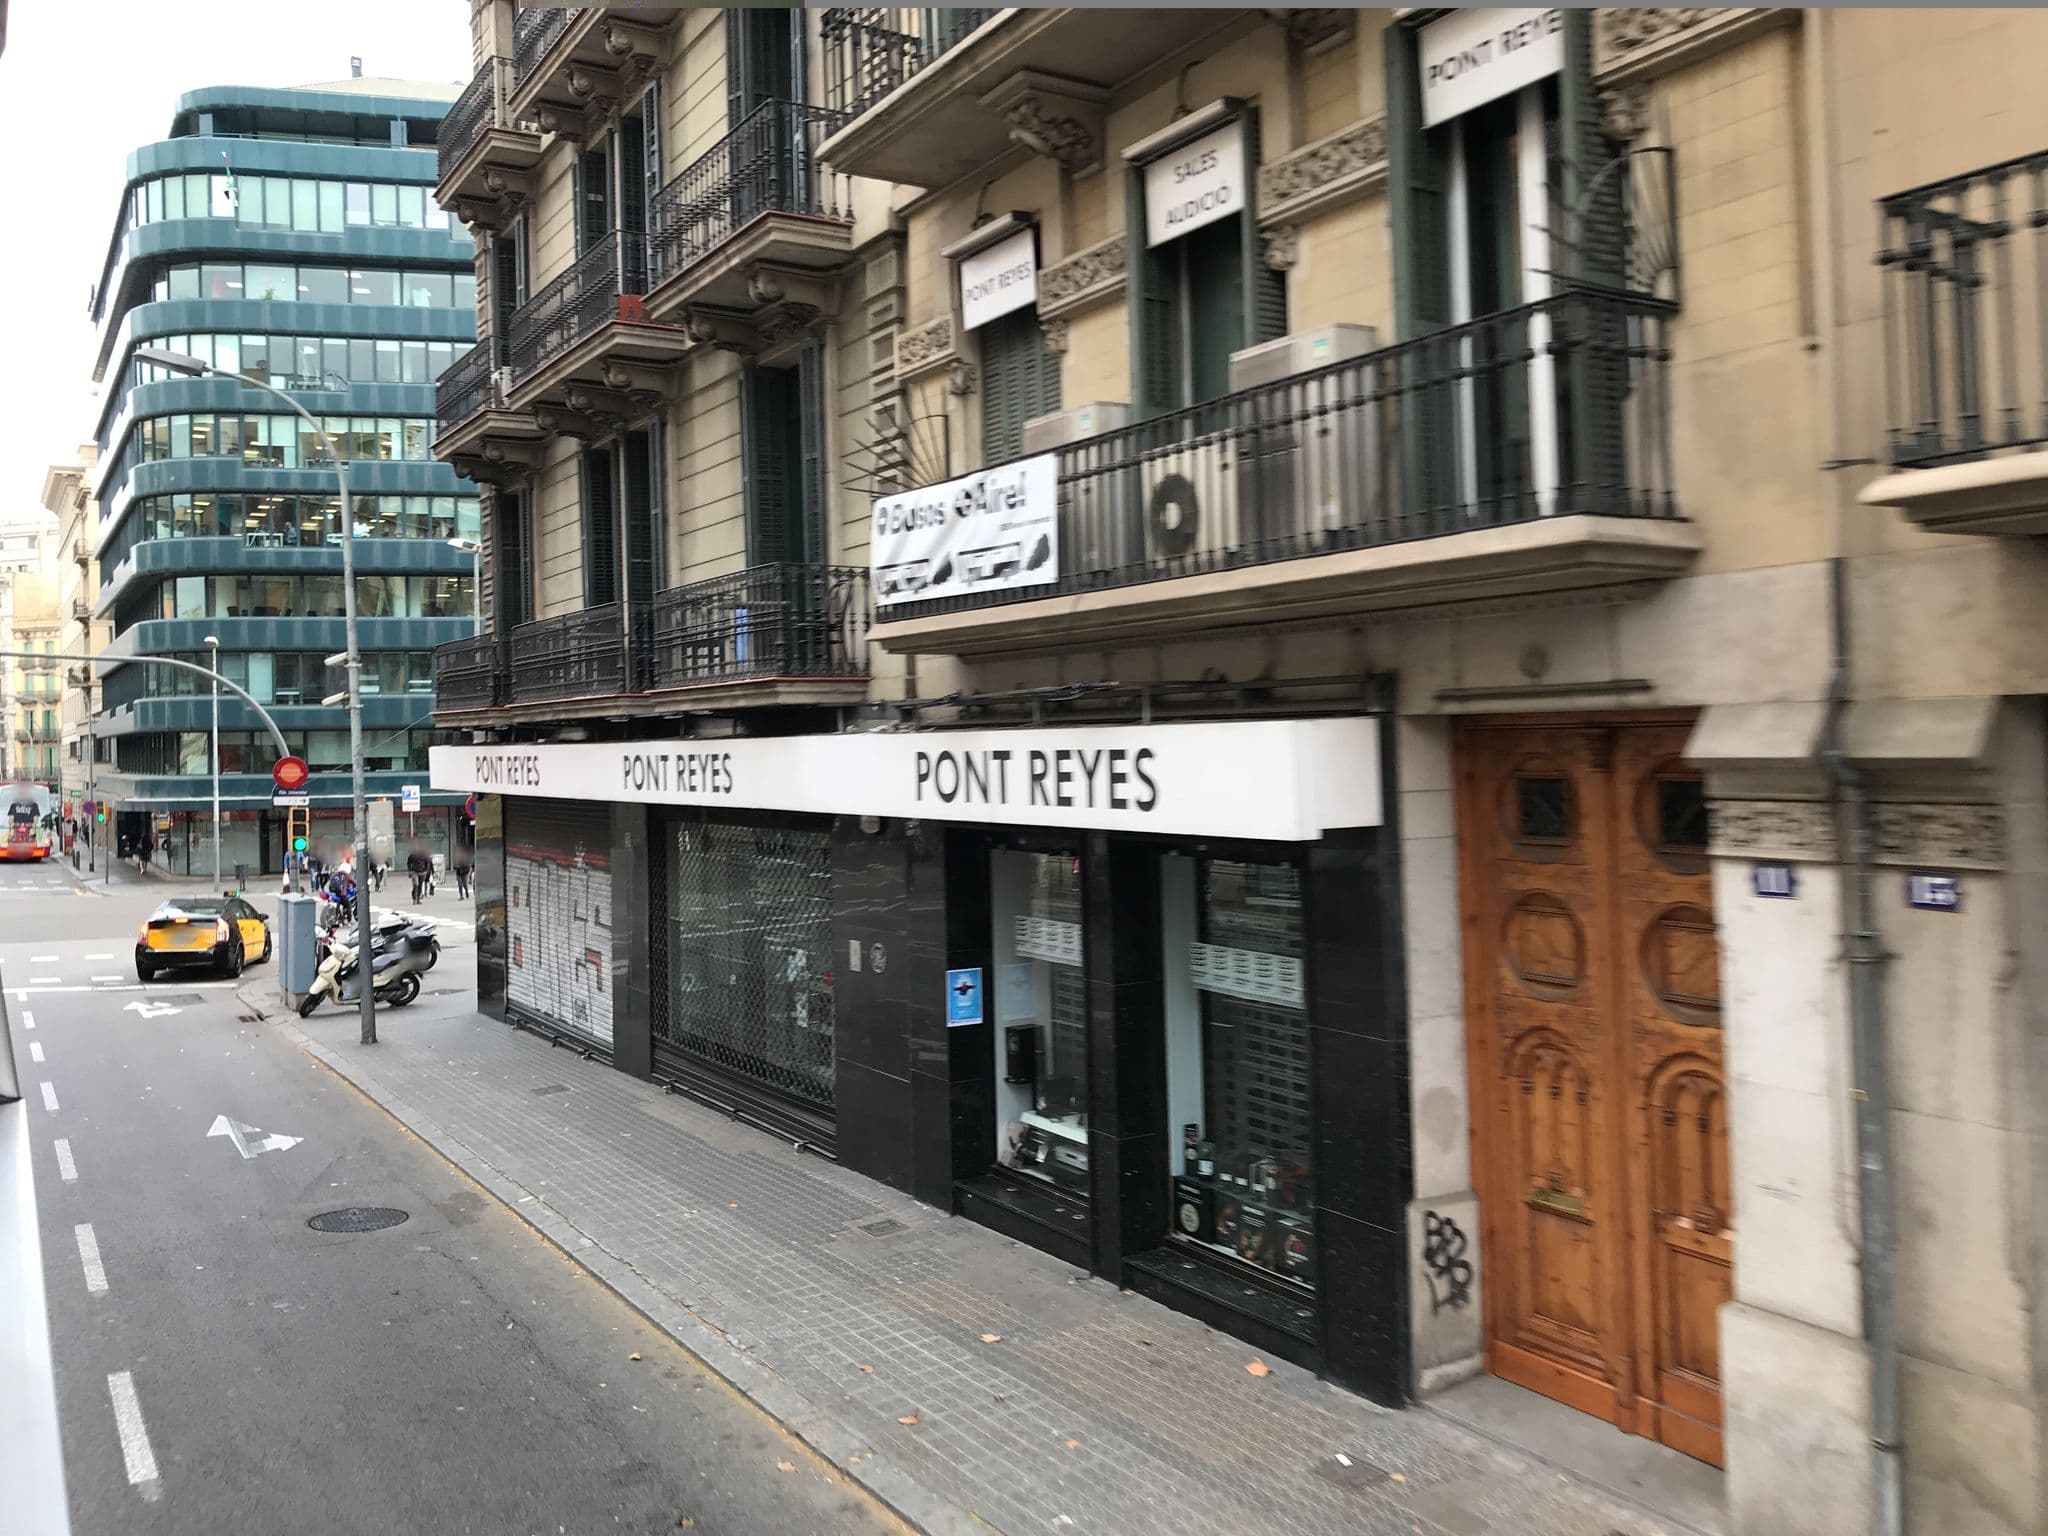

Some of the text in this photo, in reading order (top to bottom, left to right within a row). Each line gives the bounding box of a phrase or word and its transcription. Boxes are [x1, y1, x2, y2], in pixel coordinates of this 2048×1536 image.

[1428, 8, 1565, 88] PONT REYE
[1174, 149, 1218, 184] SALES
[999, 261, 1031, 288] REYES
[476, 756, 540, 786] PONT REYES
[624, 753, 733, 794] PONT REYES
[915, 748, 1158, 812] PONT REYES
